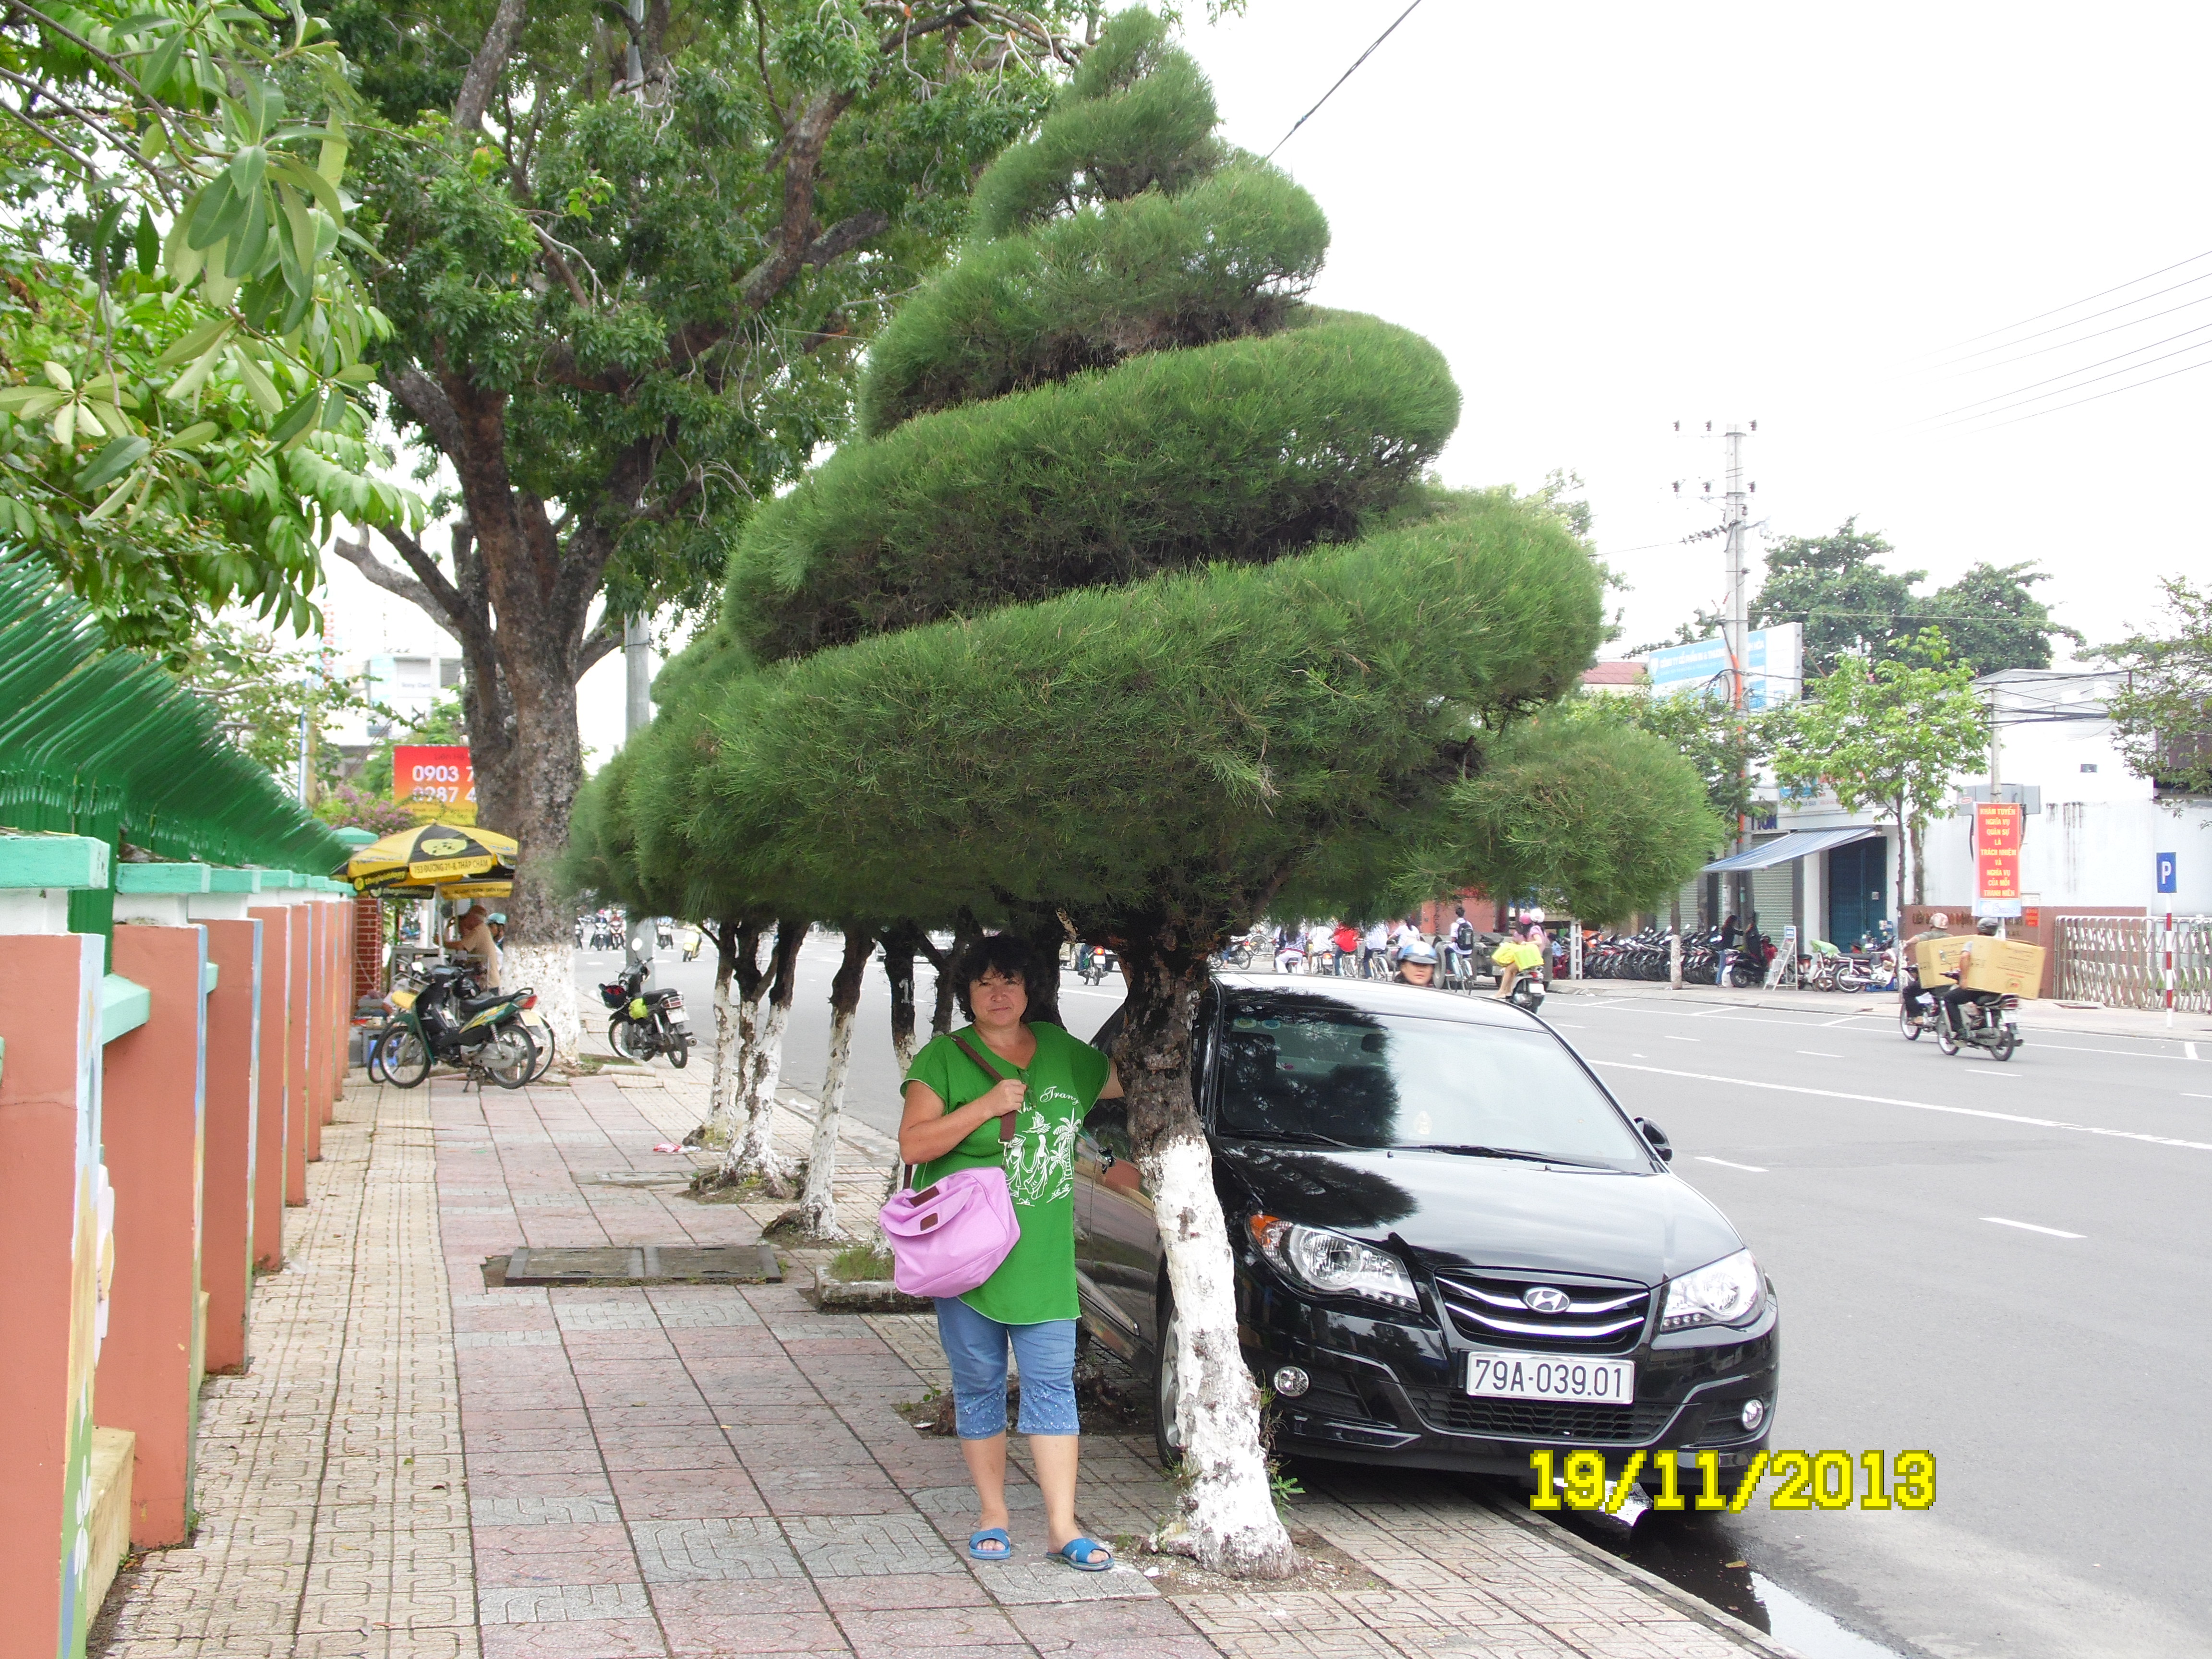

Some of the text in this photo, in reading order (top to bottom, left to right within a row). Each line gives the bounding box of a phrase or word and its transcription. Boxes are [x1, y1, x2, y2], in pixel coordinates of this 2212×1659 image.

[412, 765, 459, 782] 0903
[1986, 828, 2001, 836] QUÂN
[2162, 861, 2171, 884] P
[1988, 878, 1998, 886] CỦA
[1040, 1086, 1079, 1106] Trang
[1475, 1359, 1622, 1398] 79A-039.01
